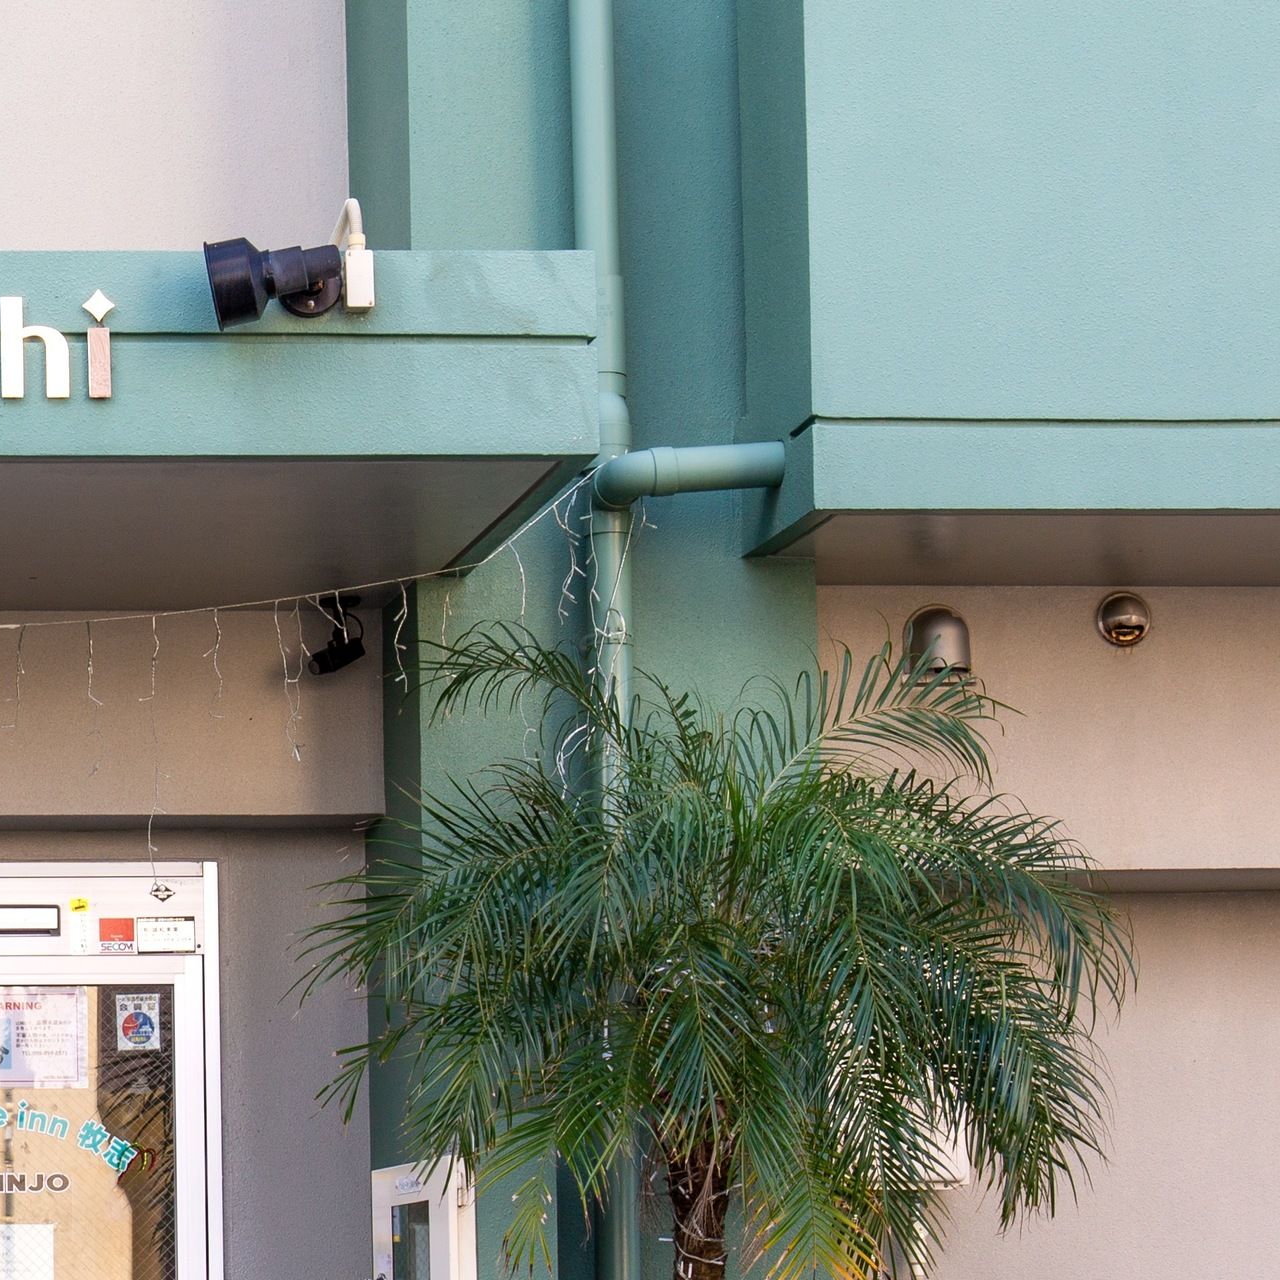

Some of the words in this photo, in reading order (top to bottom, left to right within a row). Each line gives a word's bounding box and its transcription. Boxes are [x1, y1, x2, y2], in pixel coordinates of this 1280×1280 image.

[100, 942, 134, 951] SECOM
[17, 1099, 71, 1139] inn
[76, 1118, 138, 1174] 牧志
